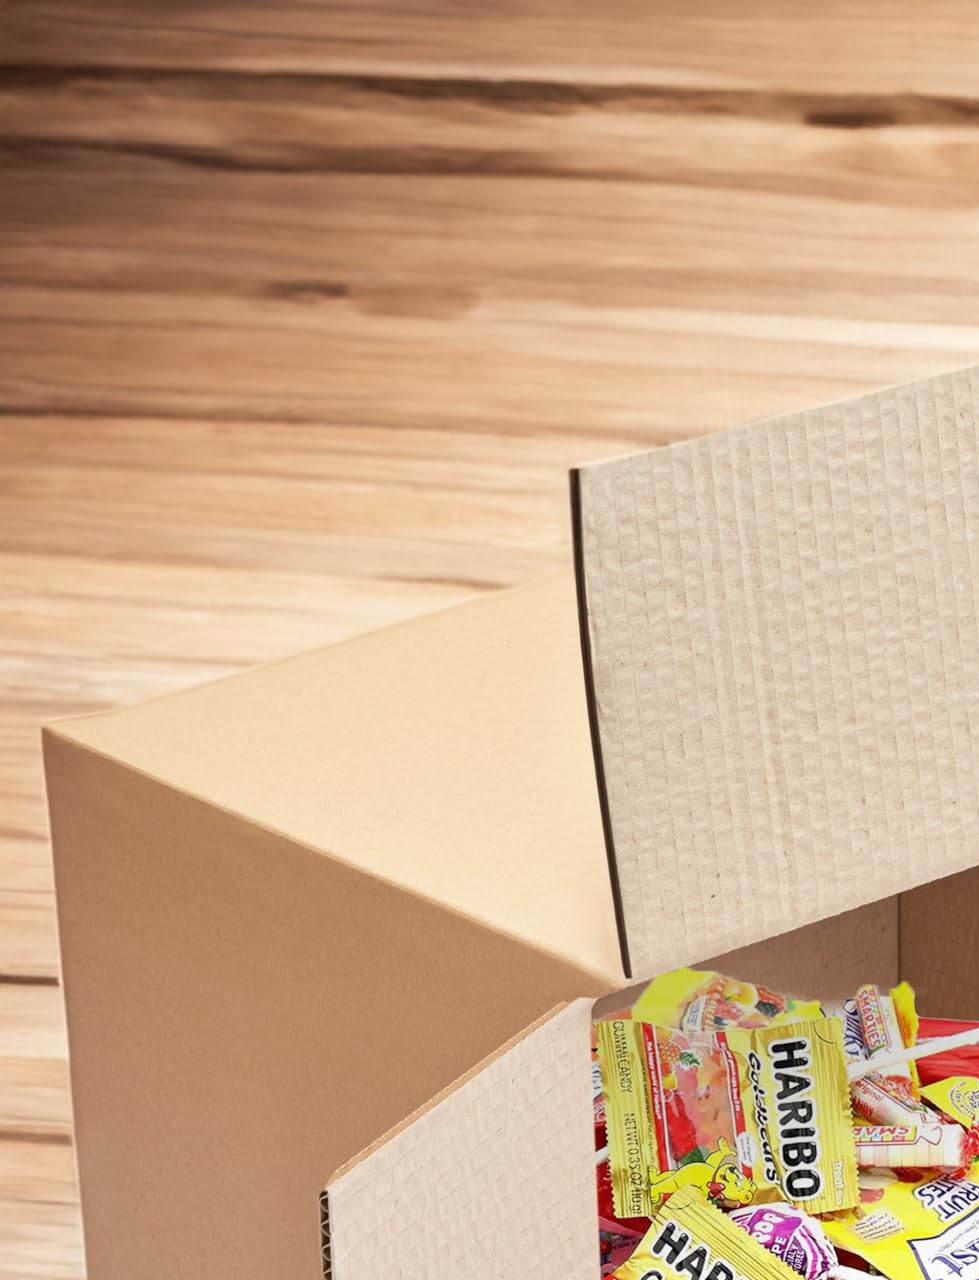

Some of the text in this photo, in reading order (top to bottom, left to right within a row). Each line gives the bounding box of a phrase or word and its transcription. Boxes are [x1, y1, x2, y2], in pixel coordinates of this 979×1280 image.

[858, 990, 881, 1050] SMARTIES
[617, 1060, 632, 1093] CANDY
[770, 1040, 821, 1200] HARIBO
[854, 1126, 910, 1138] SMAR
